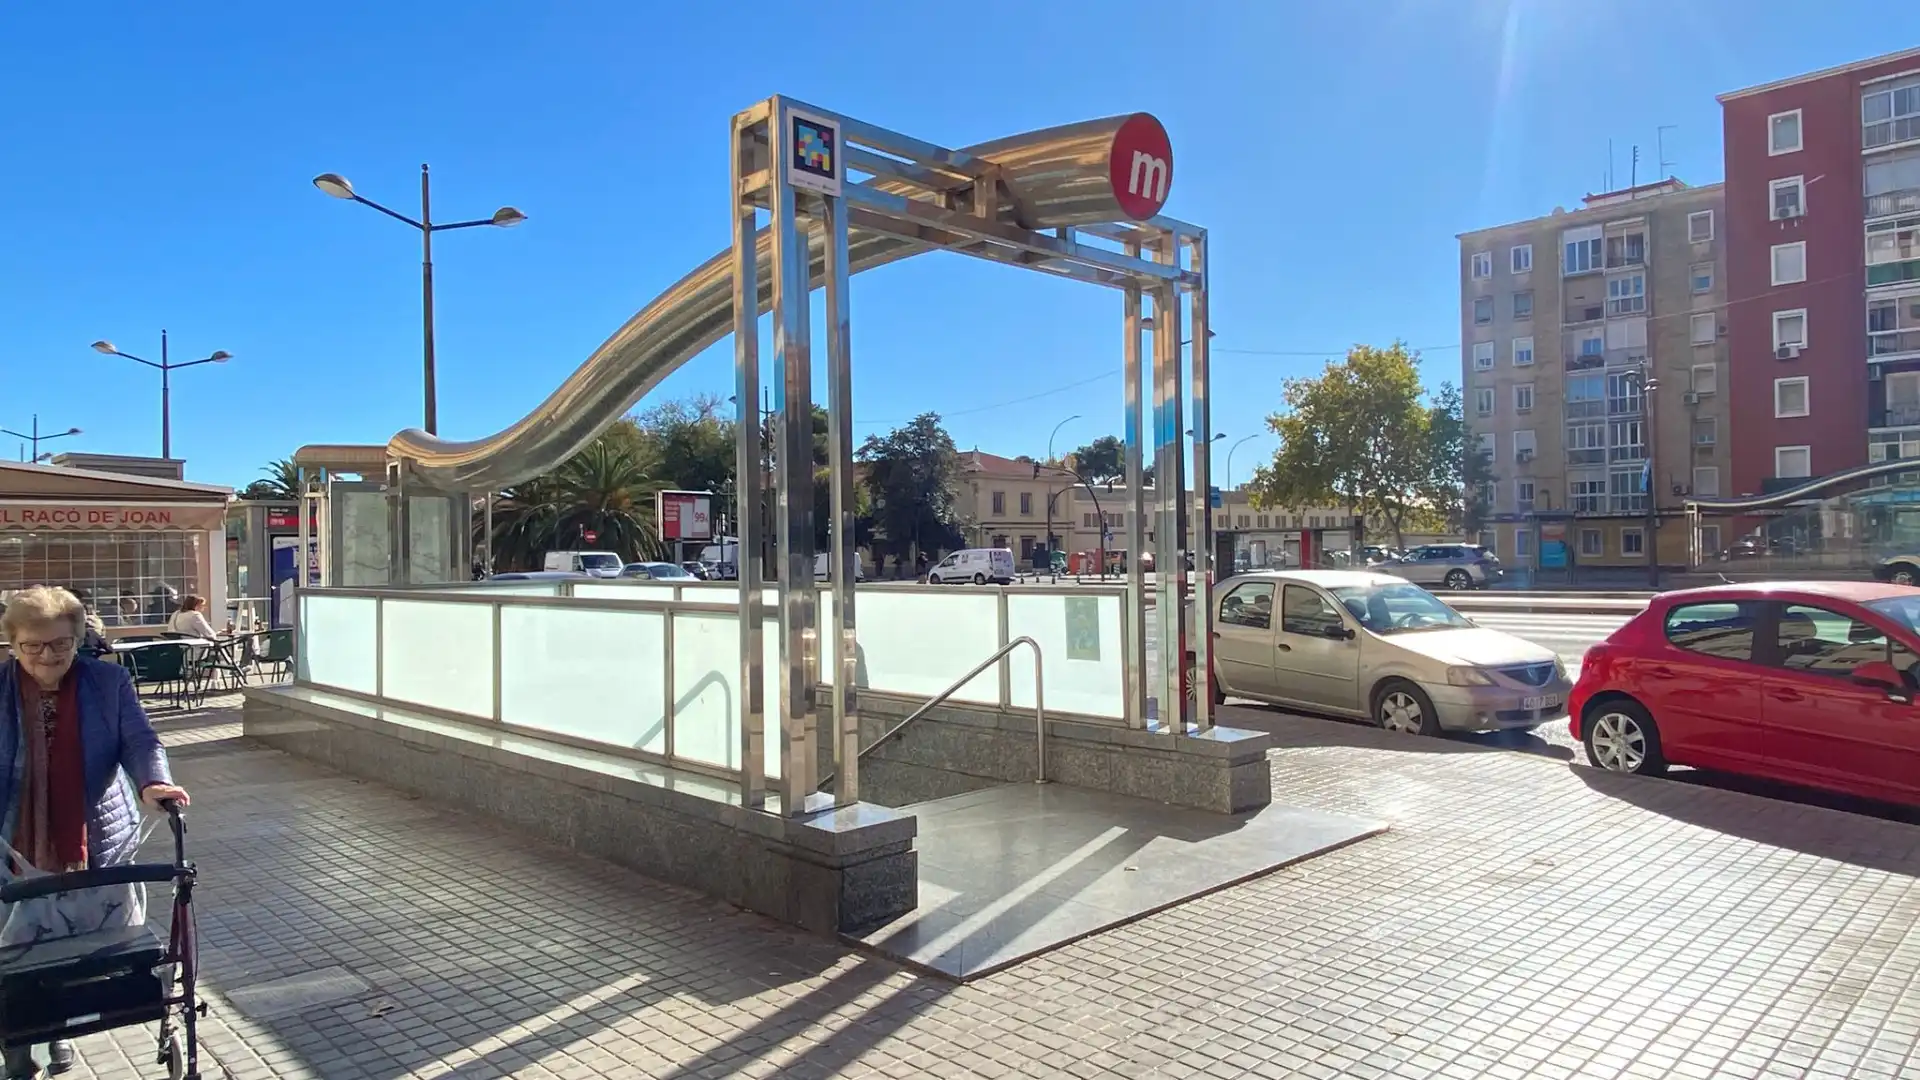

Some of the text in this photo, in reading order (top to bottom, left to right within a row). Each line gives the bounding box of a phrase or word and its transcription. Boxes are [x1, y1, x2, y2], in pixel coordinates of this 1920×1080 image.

[1128, 150, 1167, 203] m
[0, 508, 171, 523] L RACÓ DE JOAN
